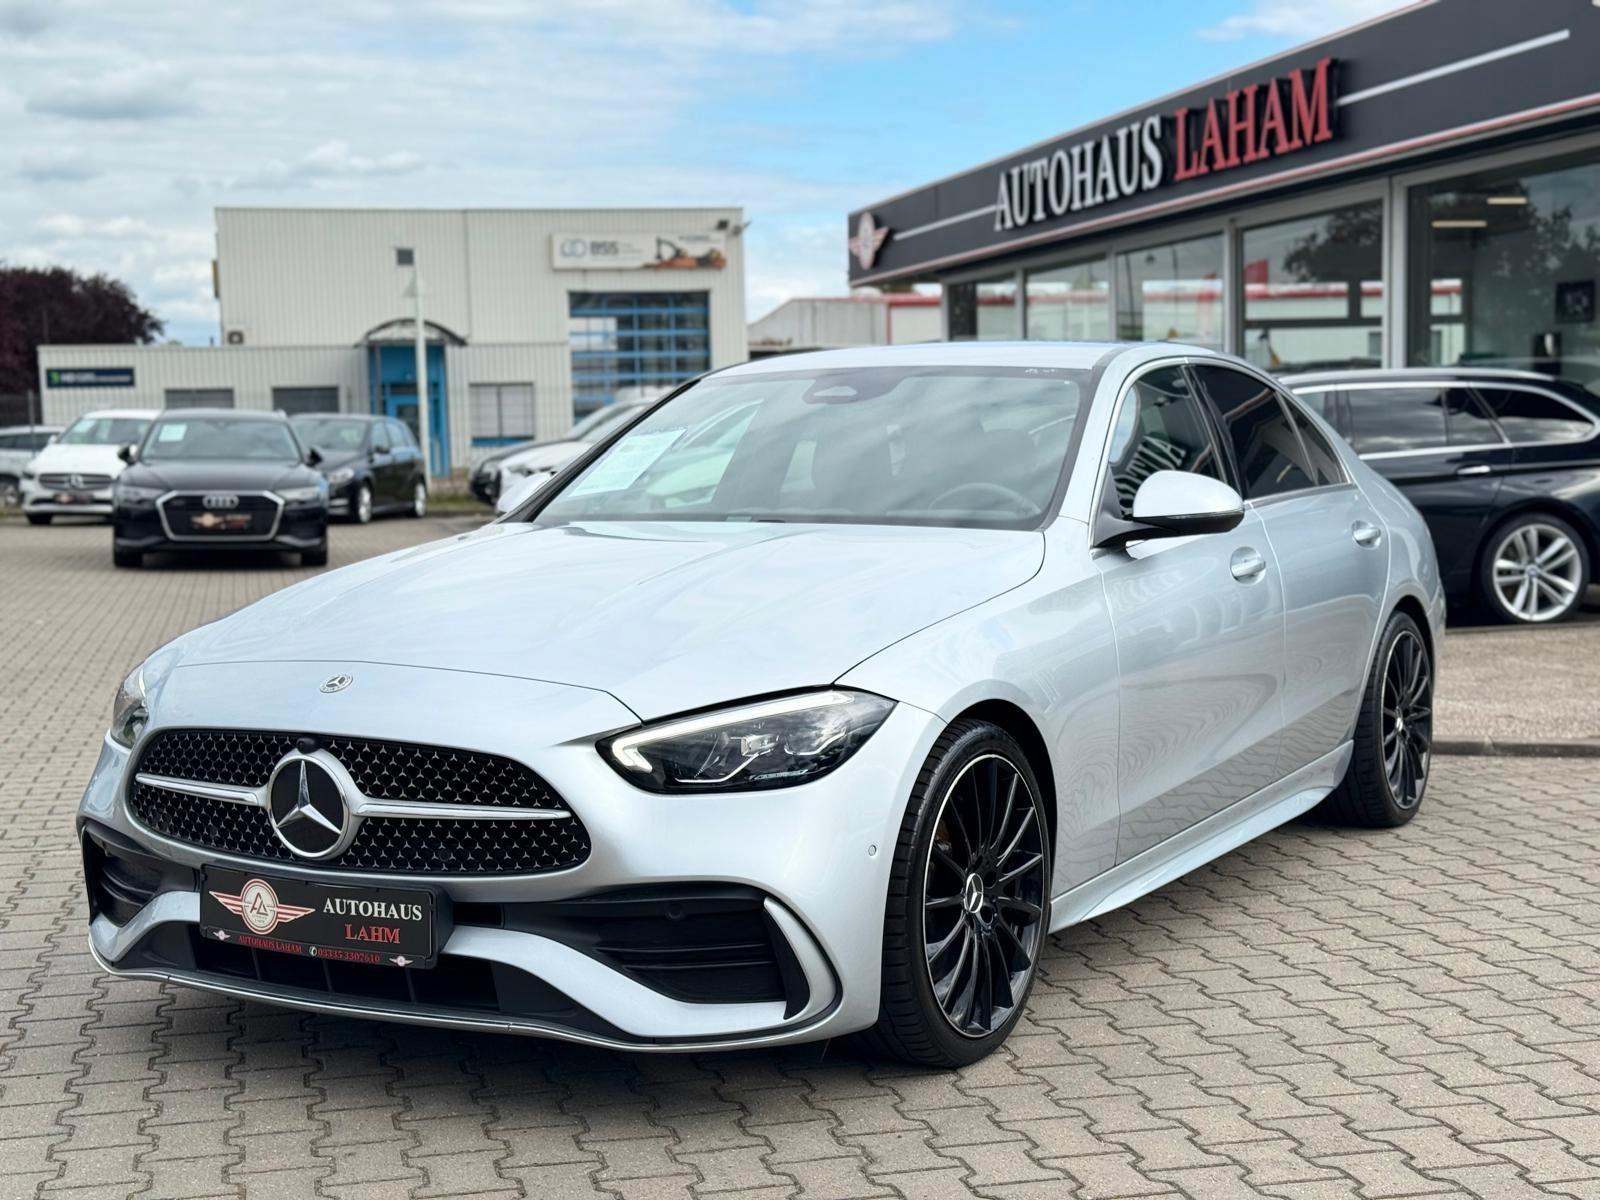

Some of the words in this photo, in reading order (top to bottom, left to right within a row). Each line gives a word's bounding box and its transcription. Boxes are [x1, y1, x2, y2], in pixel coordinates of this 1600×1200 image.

[995, 113, 1163, 231] AUTOHAUS
[1173, 57, 1333, 181] LAHAM
[323, 898, 422, 921] AUTOHAUS
[239, 935, 275, 949] AUTOHAUS
[276, 942, 302, 953] LAHAM
[345, 923, 400, 944] LAHM
